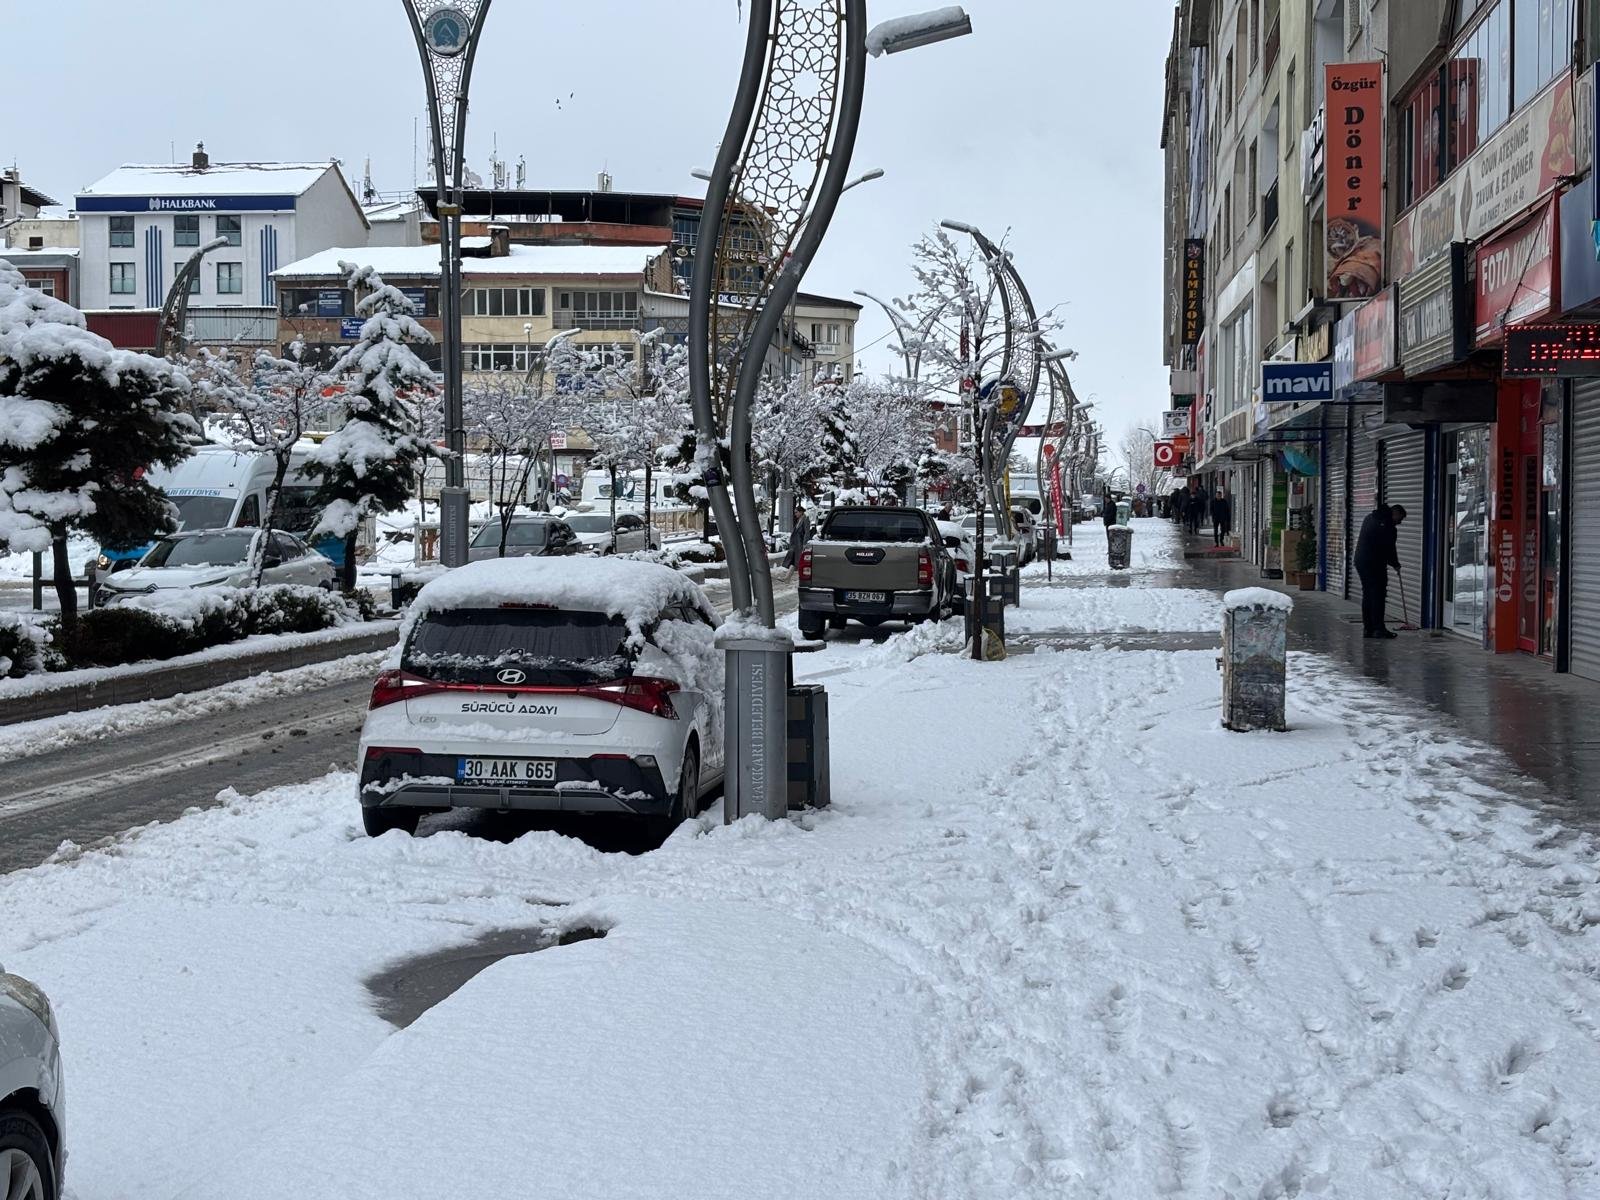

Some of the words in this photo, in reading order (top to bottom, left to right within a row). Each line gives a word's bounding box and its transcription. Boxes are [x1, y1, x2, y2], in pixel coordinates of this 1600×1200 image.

[1331, 76, 1376, 92] Özgür
[1344, 106, 1365, 210] Döner
[1476, 180, 1494, 209] TAVUK
[1501, 173, 1509, 192] ET
[1510, 151, 1534, 184] DÖNER
[161, 199, 217, 209] HALKBANK
[1481, 247, 1510, 296] FOTO
[1187, 260, 1199, 339] GAMEZONE
[1266, 371, 1330, 394] mavi
[1496, 529, 1516, 602] Özgür
[461, 701, 515, 713] SÜRÜCÜ
[518, 705, 557, 715] ADAYI
[465, 760, 483, 777] 30
[490, 761, 518, 778] AAK
[525, 762, 553, 779] 665
